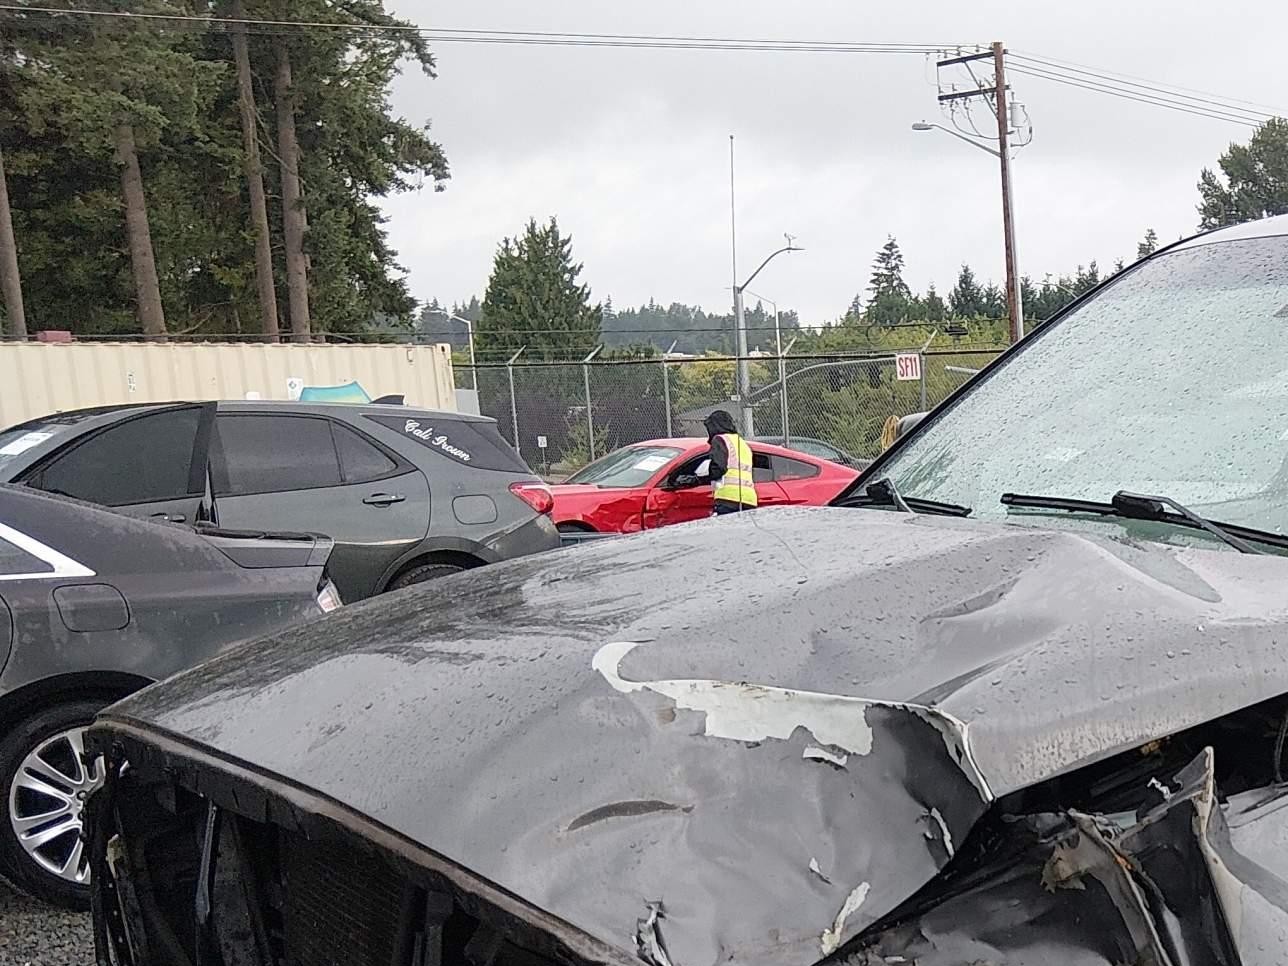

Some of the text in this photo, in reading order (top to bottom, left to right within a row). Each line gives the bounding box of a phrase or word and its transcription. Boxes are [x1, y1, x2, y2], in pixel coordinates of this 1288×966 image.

[898, 357, 918, 377] SF11
[404, 419, 471, 461] Cali Grown
